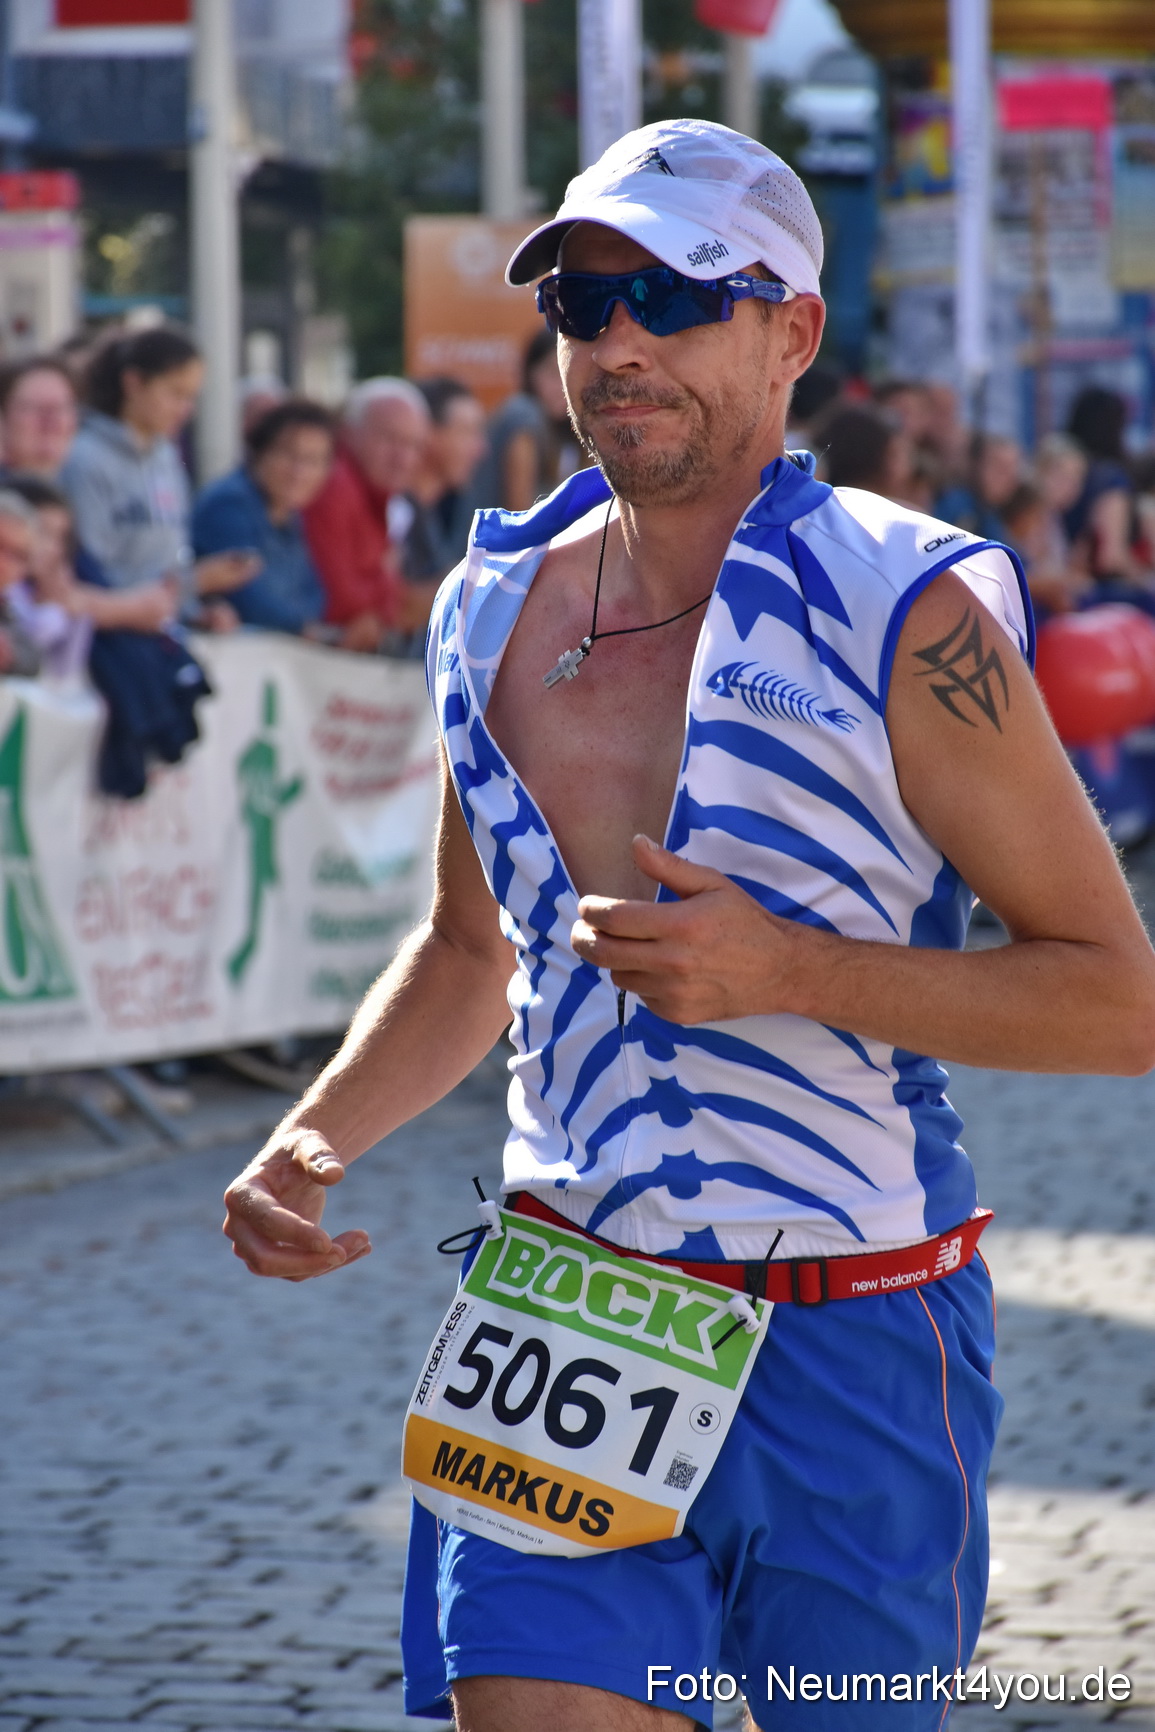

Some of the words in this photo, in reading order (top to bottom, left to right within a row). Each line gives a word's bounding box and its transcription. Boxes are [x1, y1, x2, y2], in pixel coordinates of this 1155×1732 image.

[687, 239, 729, 267] sailfish
[489, 1230, 717, 1364] BOCK
[851, 1279, 878, 1293] new
[881, 1268, 928, 1289] balance
[443, 1321, 679, 1476] 5061
[697, 1410, 713, 1428] S
[431, 1441, 615, 1537] MARKUS
